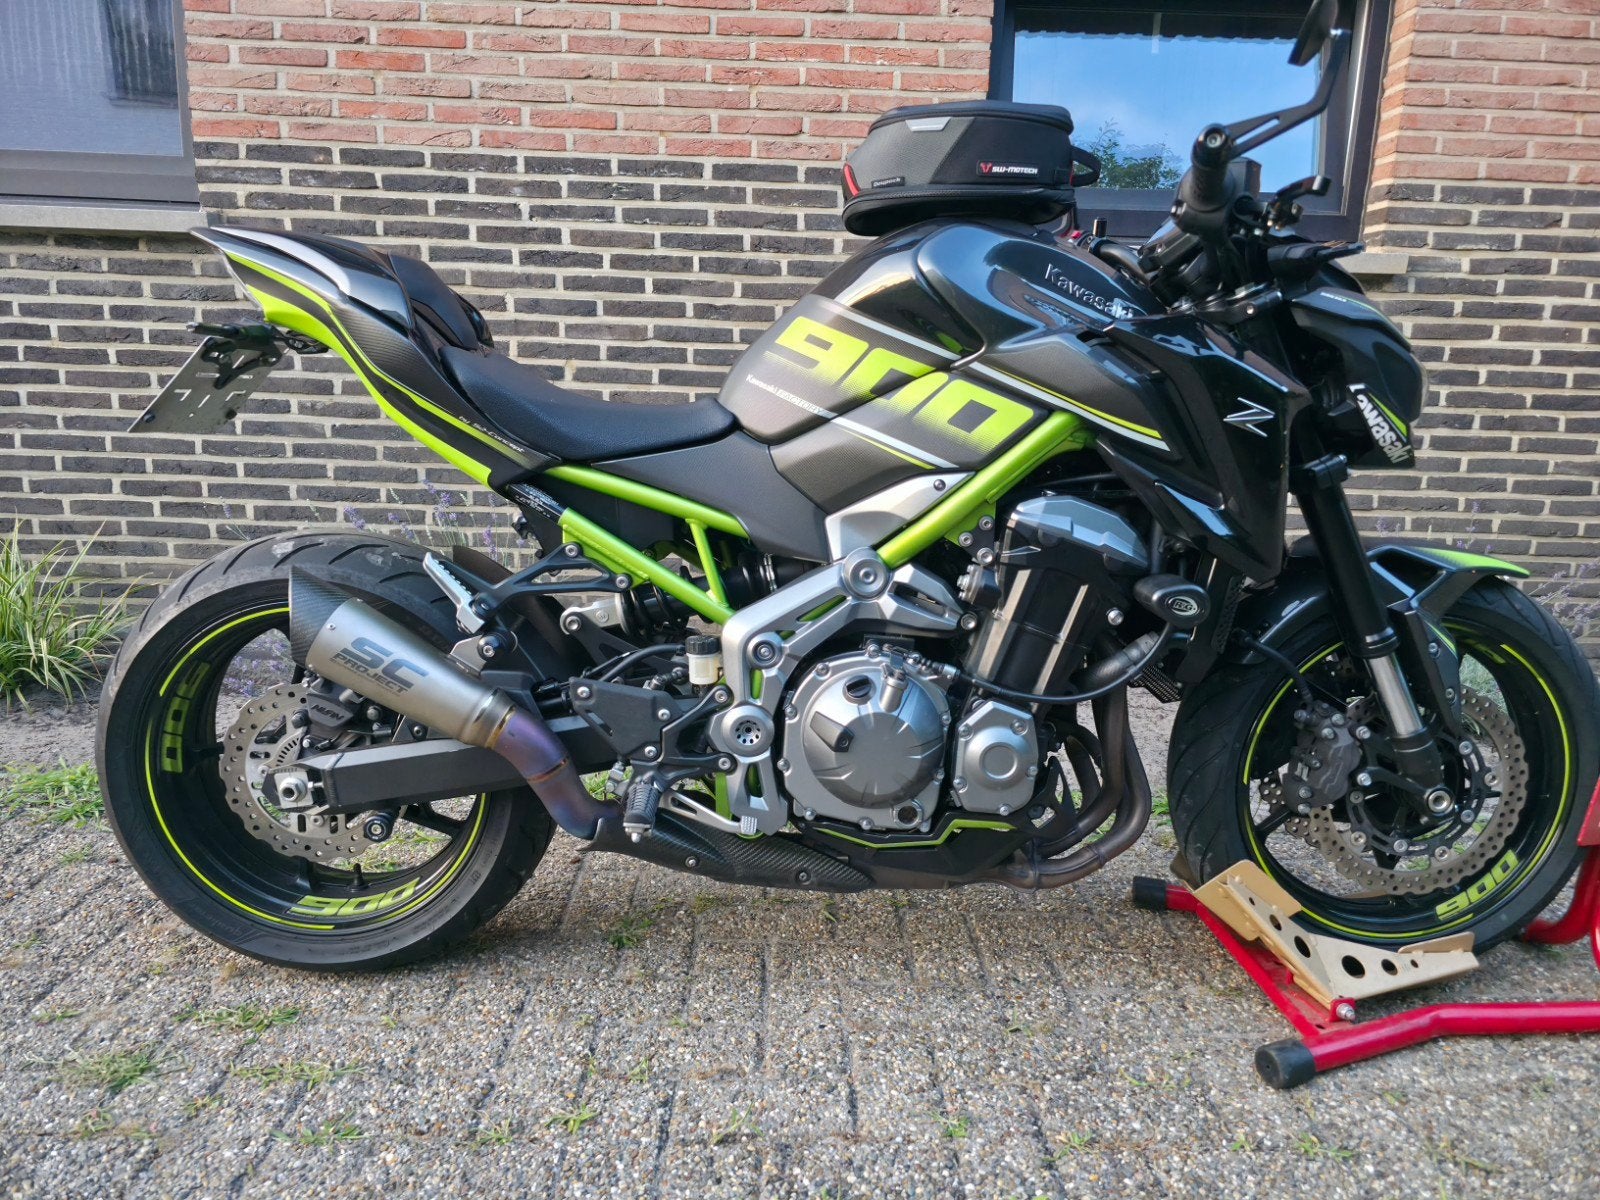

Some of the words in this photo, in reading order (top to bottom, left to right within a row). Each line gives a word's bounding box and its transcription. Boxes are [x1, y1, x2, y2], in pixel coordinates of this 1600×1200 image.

[991, 166, 1039, 176] SW-MOTECH
[1044, 263, 1135, 320] Kawasaki
[763, 316, 1035, 454] 900
[329, 652, 409, 694] PROJECT
[340, 637, 430, 689] SC
[287, 876, 421, 917] 900
[1435, 849, 1521, 922] 900
